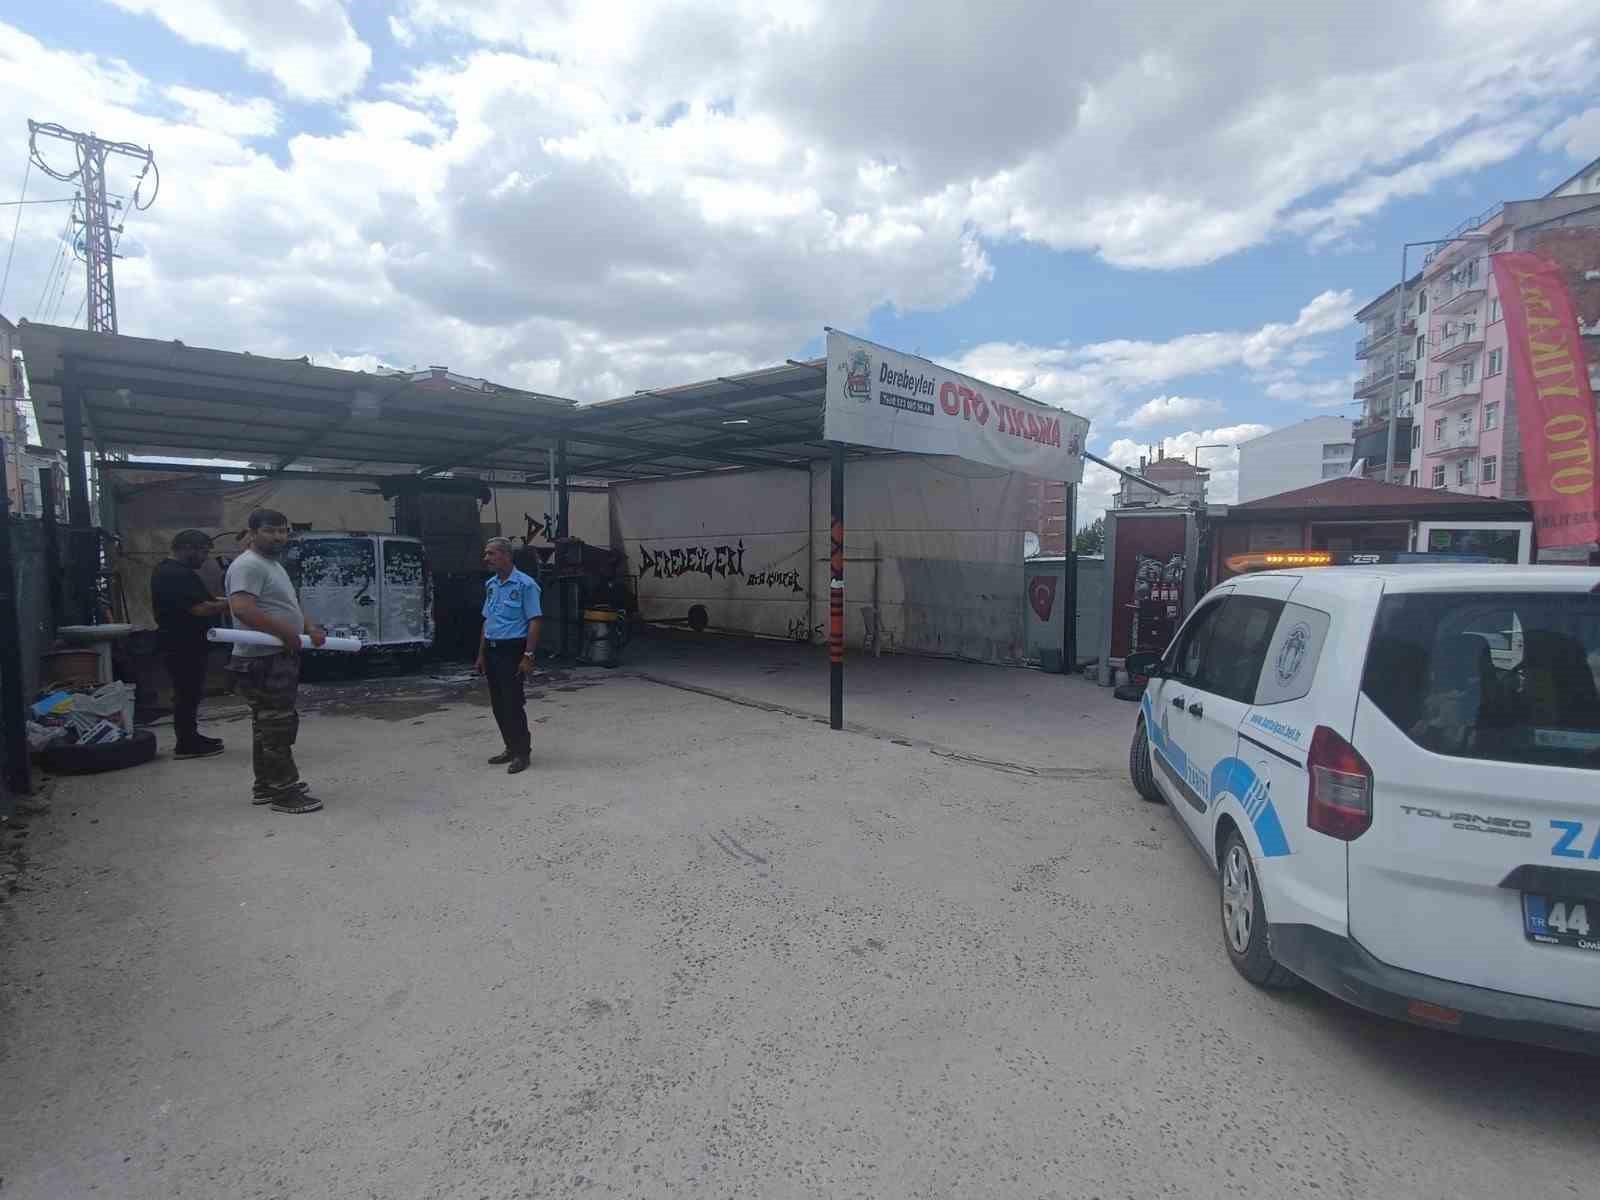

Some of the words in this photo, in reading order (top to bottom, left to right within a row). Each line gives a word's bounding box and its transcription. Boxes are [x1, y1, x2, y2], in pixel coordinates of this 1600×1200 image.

[879, 361, 936, 396] Derebeyleri
[939, 381, 990, 426] OTO
[991, 400, 1061, 447] YIKAMA
[1400, 804, 1531, 830] TOURNEO
[1530, 916, 1546, 928] TR
[1547, 901, 1590, 936] 44
